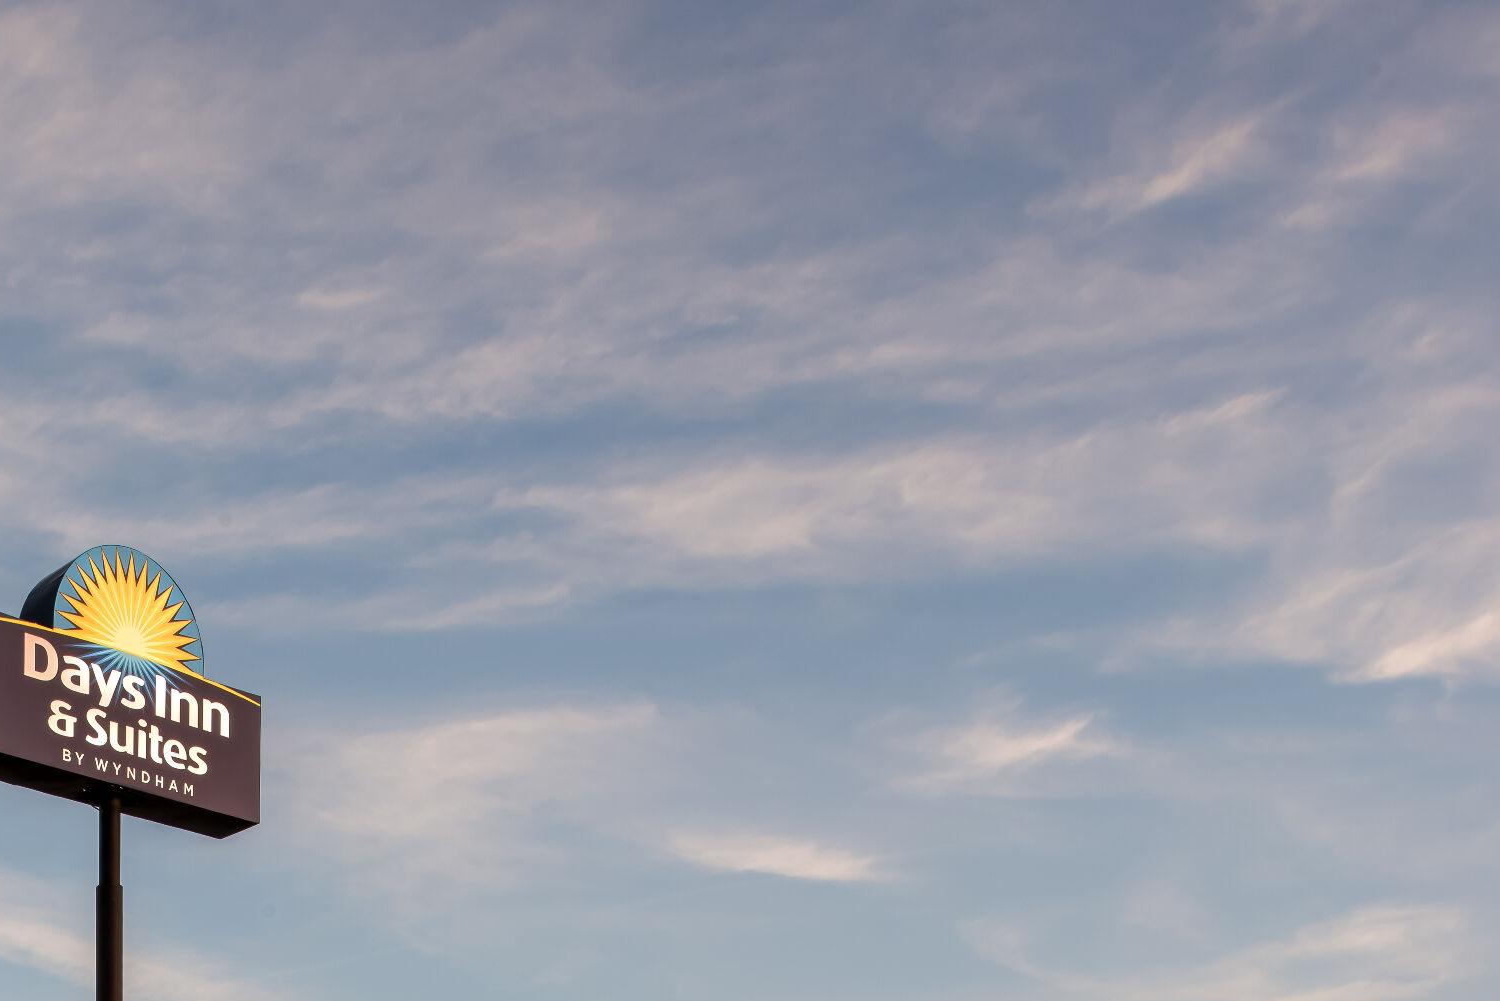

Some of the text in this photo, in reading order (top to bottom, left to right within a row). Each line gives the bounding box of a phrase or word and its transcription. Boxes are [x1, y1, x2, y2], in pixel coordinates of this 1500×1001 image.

[23, 632, 230, 739] Days Inn
[47, 699, 208, 776] & Suites
[62, 748, 195, 797] BY WYNDHAM
